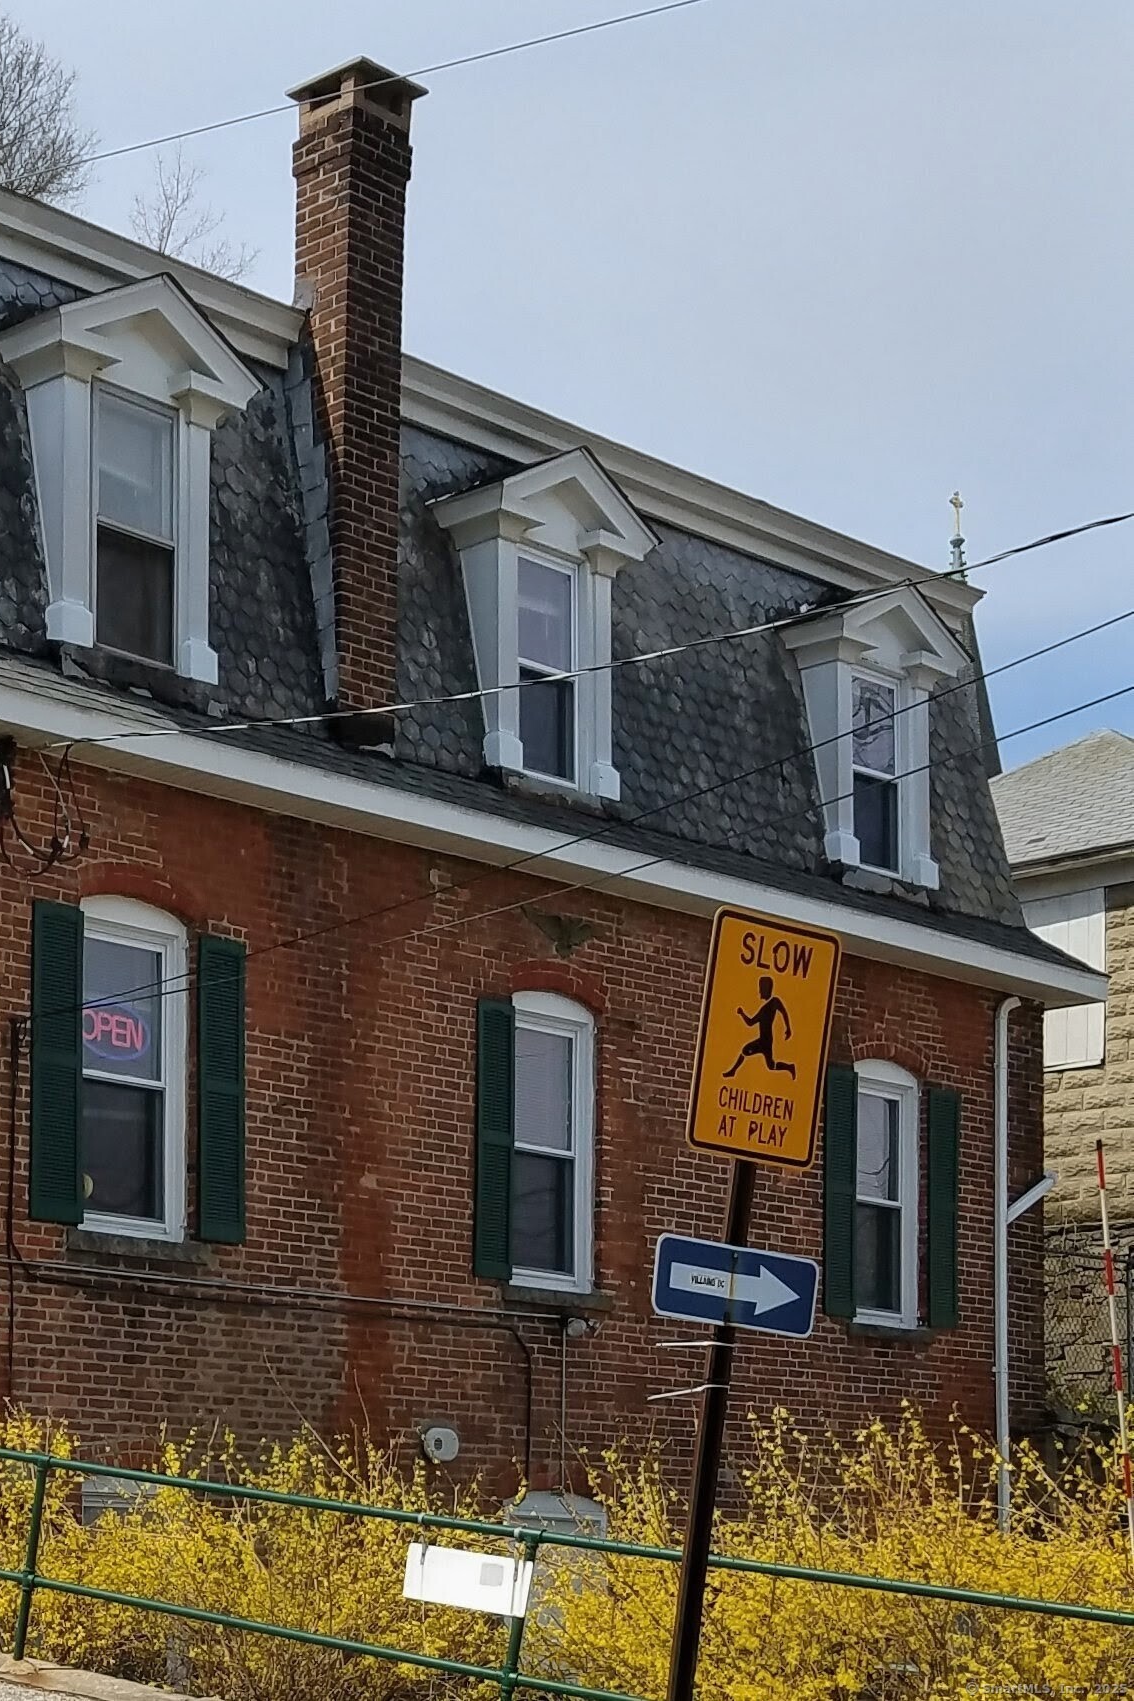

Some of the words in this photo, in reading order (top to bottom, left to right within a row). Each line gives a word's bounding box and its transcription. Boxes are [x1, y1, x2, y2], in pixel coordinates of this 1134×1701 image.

[740, 932, 813, 978] SLOW
[82, 1008, 143, 1051] OPEN
[718, 1086, 794, 1121] CHILDREN
[718, 1115, 737, 1137] AT
[747, 1120, 788, 1147] PLAY
